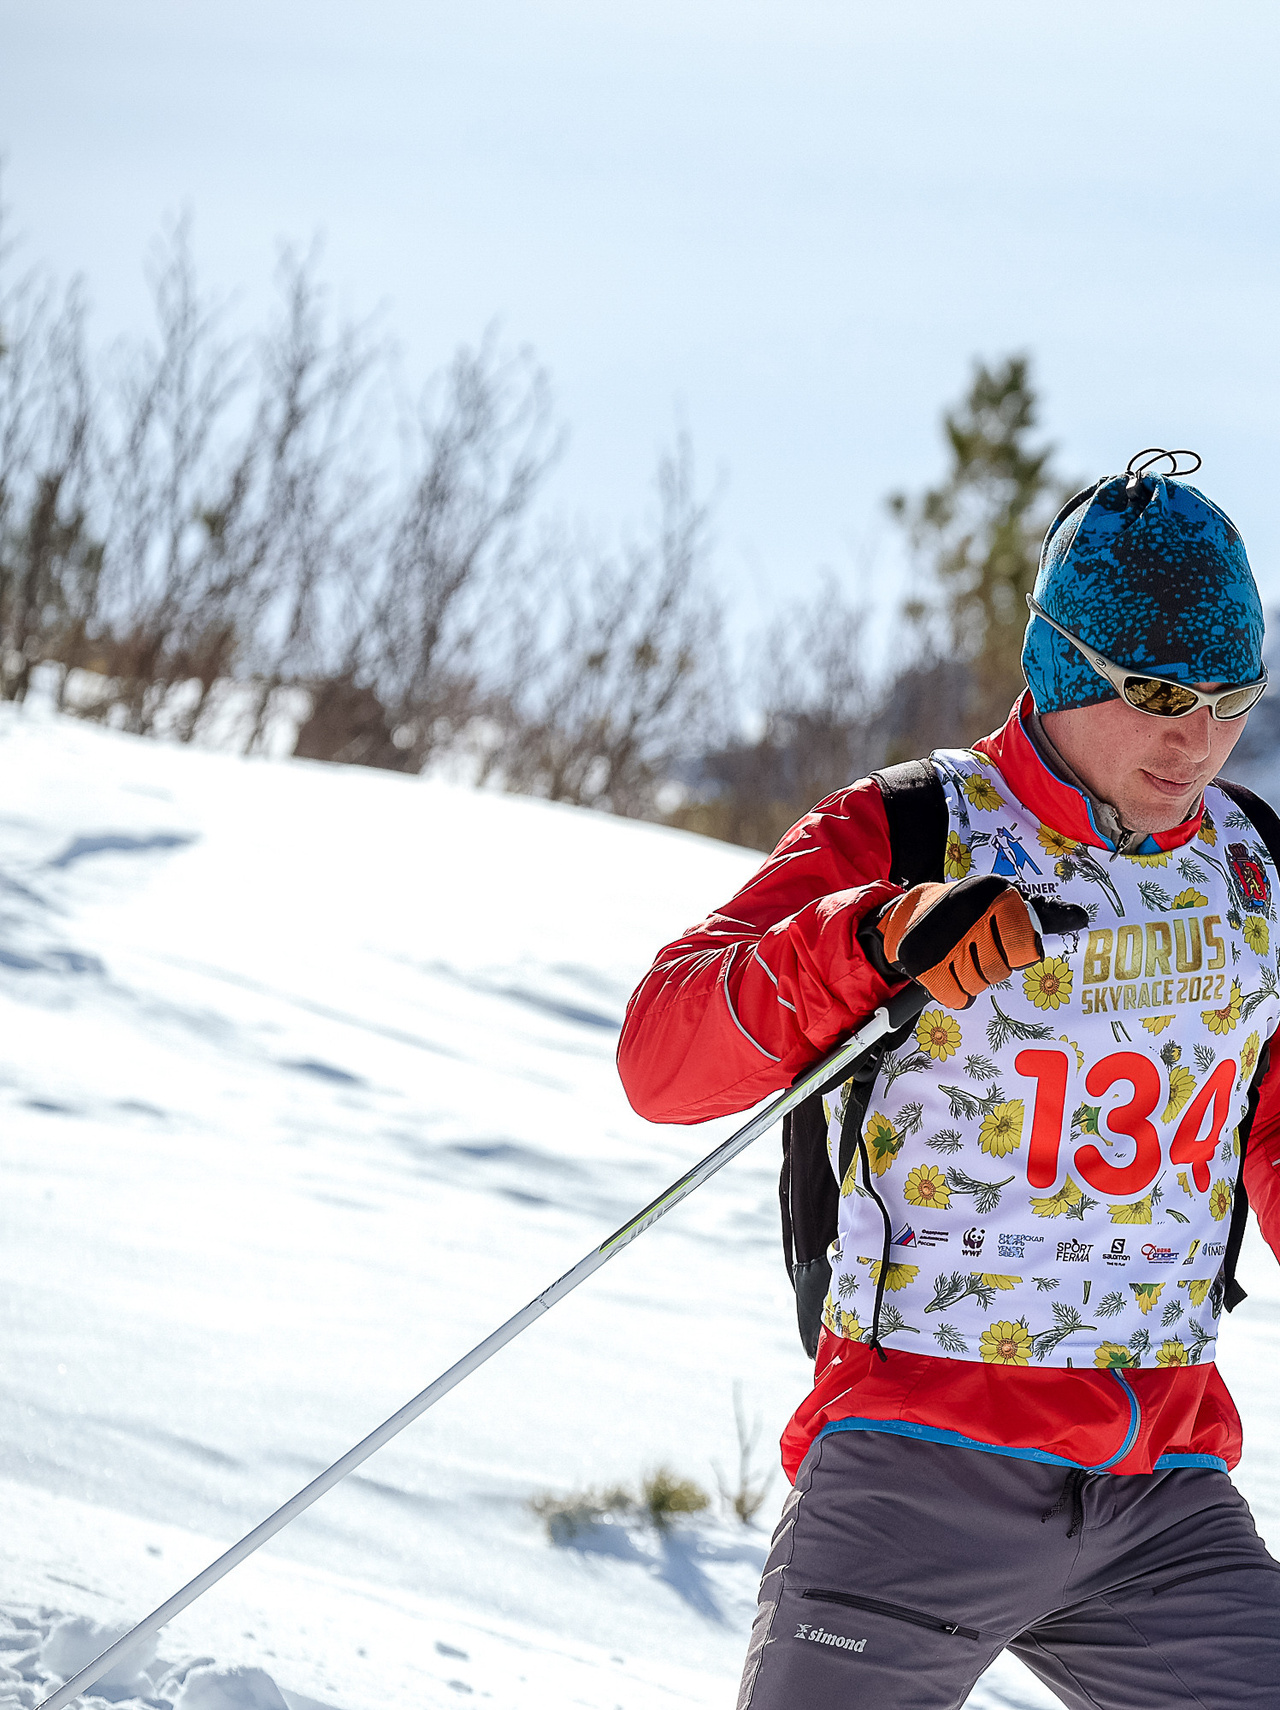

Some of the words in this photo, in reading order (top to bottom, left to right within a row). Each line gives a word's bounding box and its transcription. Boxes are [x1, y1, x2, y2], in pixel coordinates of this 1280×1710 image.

[1082, 915, 1226, 985] BORUS
[1081, 981, 1174, 1015] SKYRACE
[1175, 974, 1226, 1005] 2022
[1014, 1048, 1237, 1196] 134
[962, 1249, 982, 1257] WWF
[1056, 1251, 1090, 1262] FERMA
[1057, 1239, 1094, 1254] SPORT
[808, 1627, 868, 1653] simond
